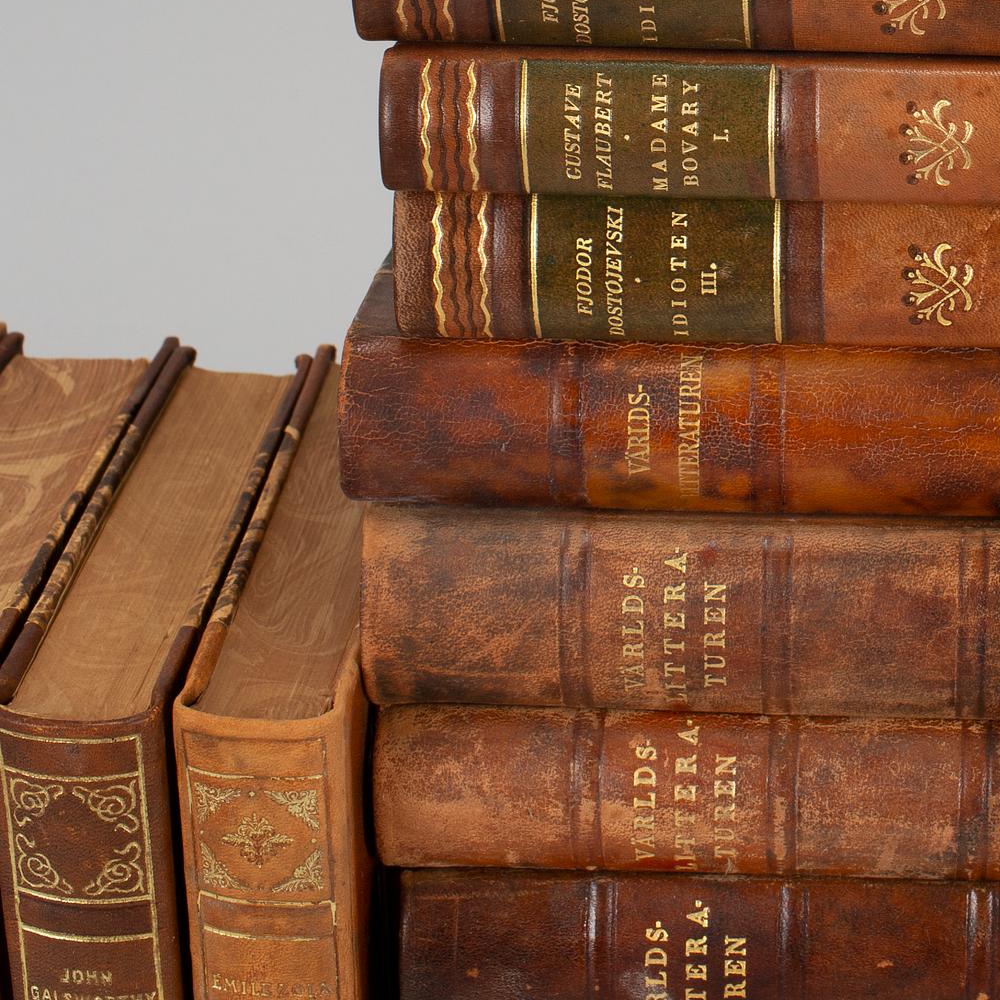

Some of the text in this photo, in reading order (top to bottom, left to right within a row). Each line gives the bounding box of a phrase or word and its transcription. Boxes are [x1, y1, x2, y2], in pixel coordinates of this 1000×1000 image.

[563, 83, 582, 180] GUSTAVE
[594, 72, 613, 191] FLAUBERT
[650, 74, 669, 192] MADAME
[681, 80, 700, 187] BOVARY
[576, 237, 594, 316] FJODOR
[604, 205, 625, 337] DOSTOJEVSKI
[670, 211, 689, 337] IDIOTEN
[703, 581, 727, 688] TUREN
[713, 753, 737, 858] TUREN
[60, 967, 113, 986] JOHN
